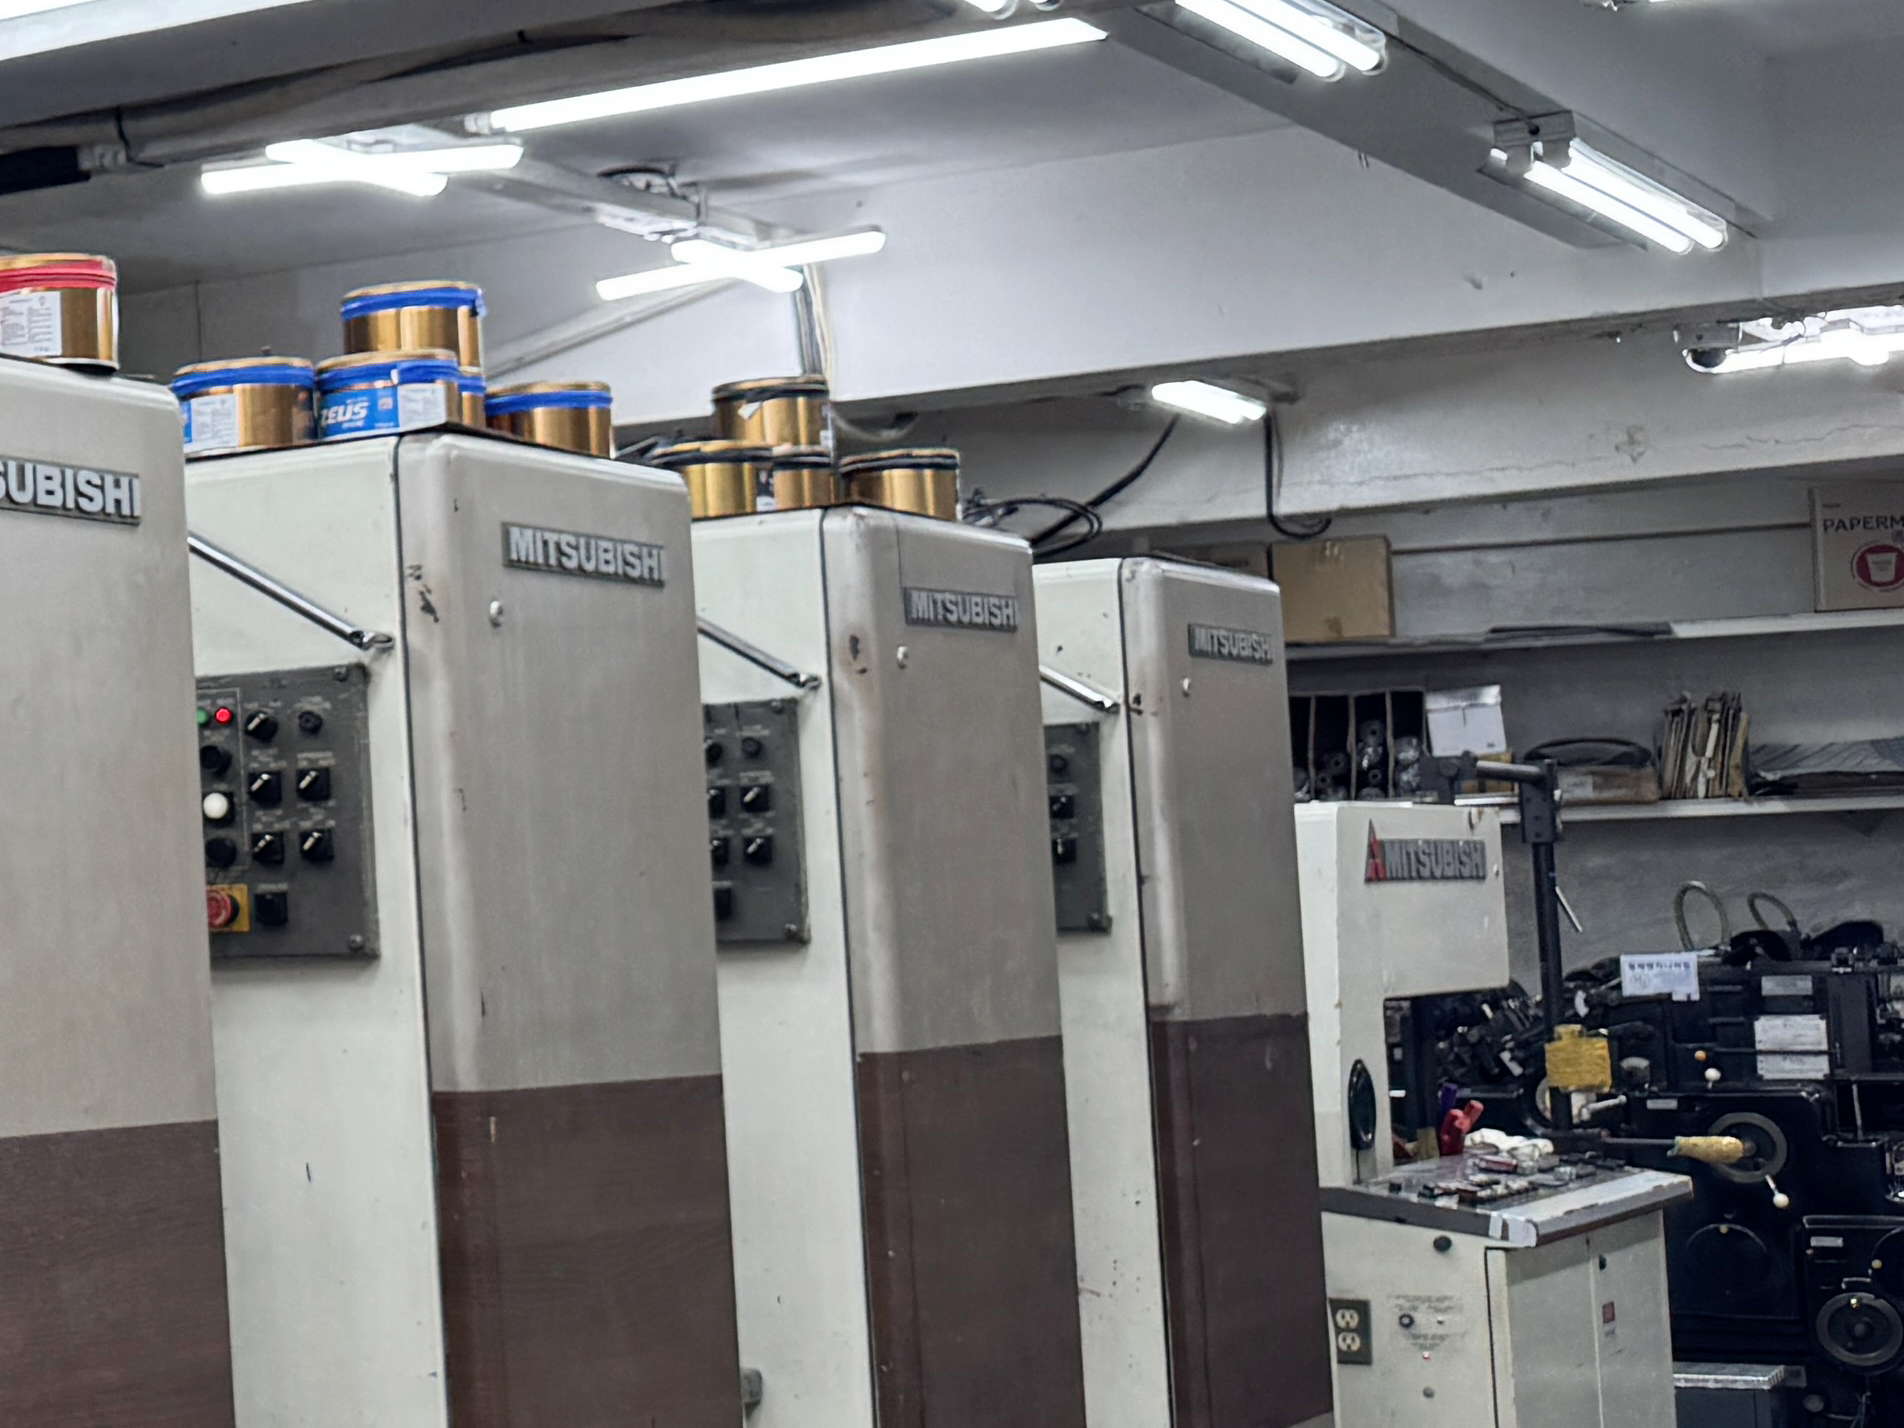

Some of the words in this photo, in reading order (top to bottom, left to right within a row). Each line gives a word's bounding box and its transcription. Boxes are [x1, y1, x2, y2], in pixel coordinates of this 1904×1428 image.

[508, 526, 666, 582] MITSUBISHI
[911, 590, 1019, 627] MITSUBISHI
[1384, 840, 1486, 880] MITSUBISHI
